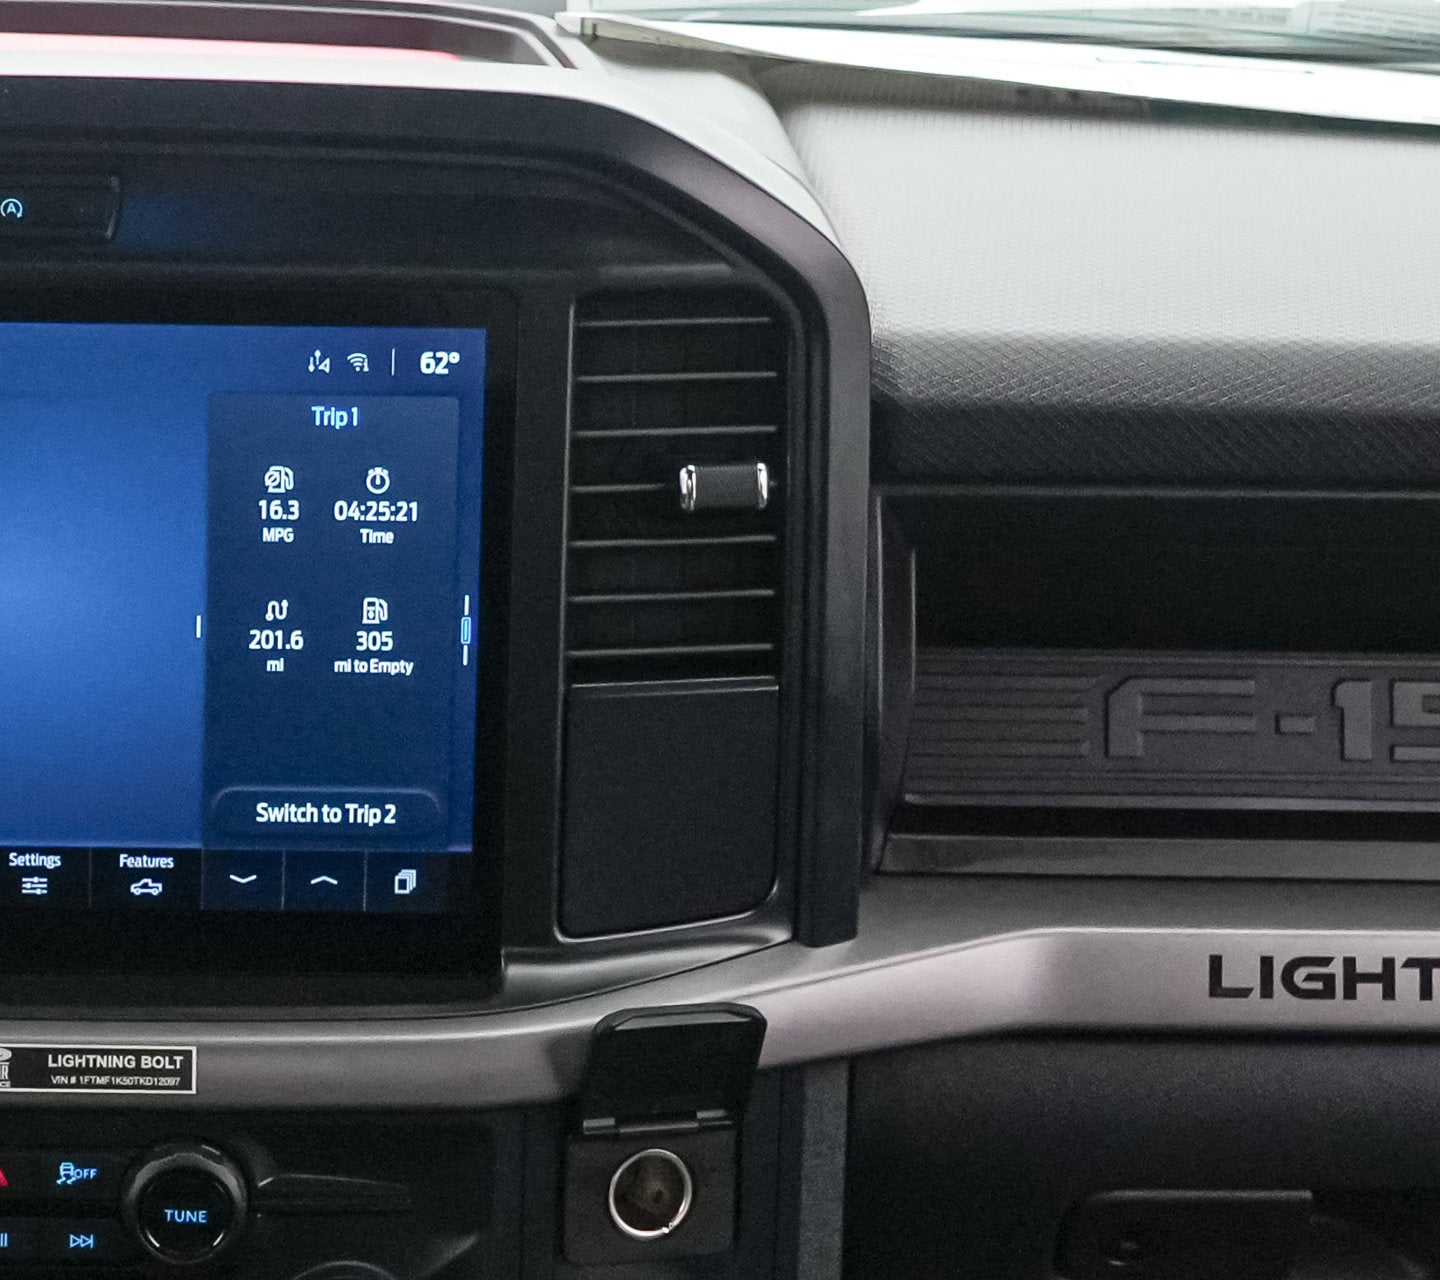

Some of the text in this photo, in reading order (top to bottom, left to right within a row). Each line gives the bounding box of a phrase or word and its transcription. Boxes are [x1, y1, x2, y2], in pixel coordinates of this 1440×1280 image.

[420, 352, 460, 374] 62°
[311, 406, 360, 429] Trip 1
[259, 500, 299, 520] 16.3
[334, 501, 417, 521] 04:25:21
[263, 527, 294, 542] MPG
[360, 529, 394, 544] Time
[249, 630, 303, 649] 201.6
[356, 631, 393, 651] 305
[267, 658, 284, 671] mi
[334, 659, 413, 675] mi to Empty
[256, 802, 396, 826] Switch to Trip 2
[9, 853, 61, 869] Settings
[120, 854, 174, 868] Features
[48, 1054, 184, 1070] LIGHTNING BOLT
[51, 1075, 69, 1085] VIN
[73, 1166, 98, 1179] OFF
[164, 1209, 207, 1223] TUNE
